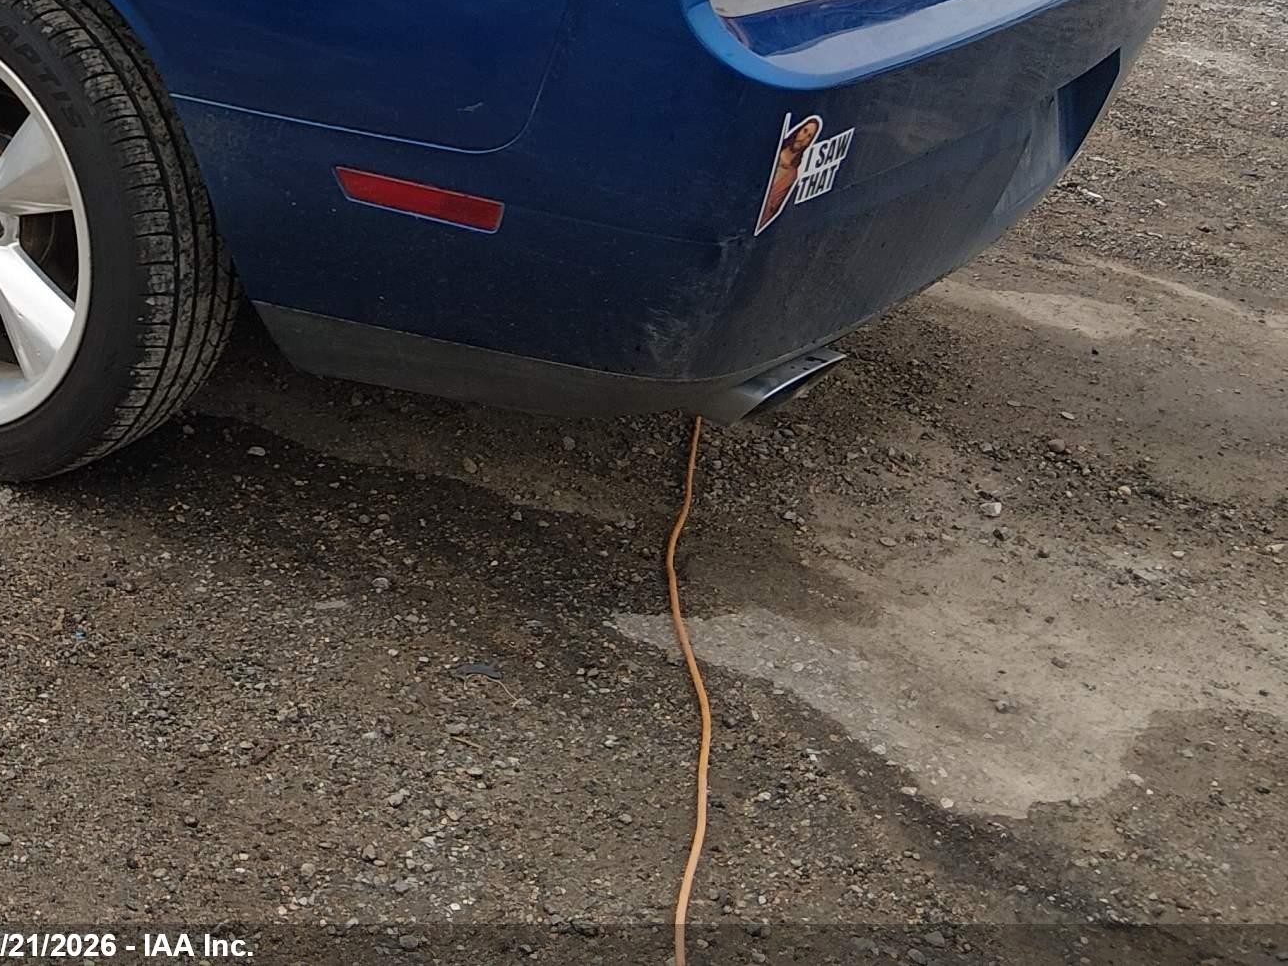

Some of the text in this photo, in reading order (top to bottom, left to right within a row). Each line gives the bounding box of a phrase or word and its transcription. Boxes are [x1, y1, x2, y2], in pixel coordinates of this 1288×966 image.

[803, 131, 852, 173] I SAW
[797, 164, 838, 202] THAT
